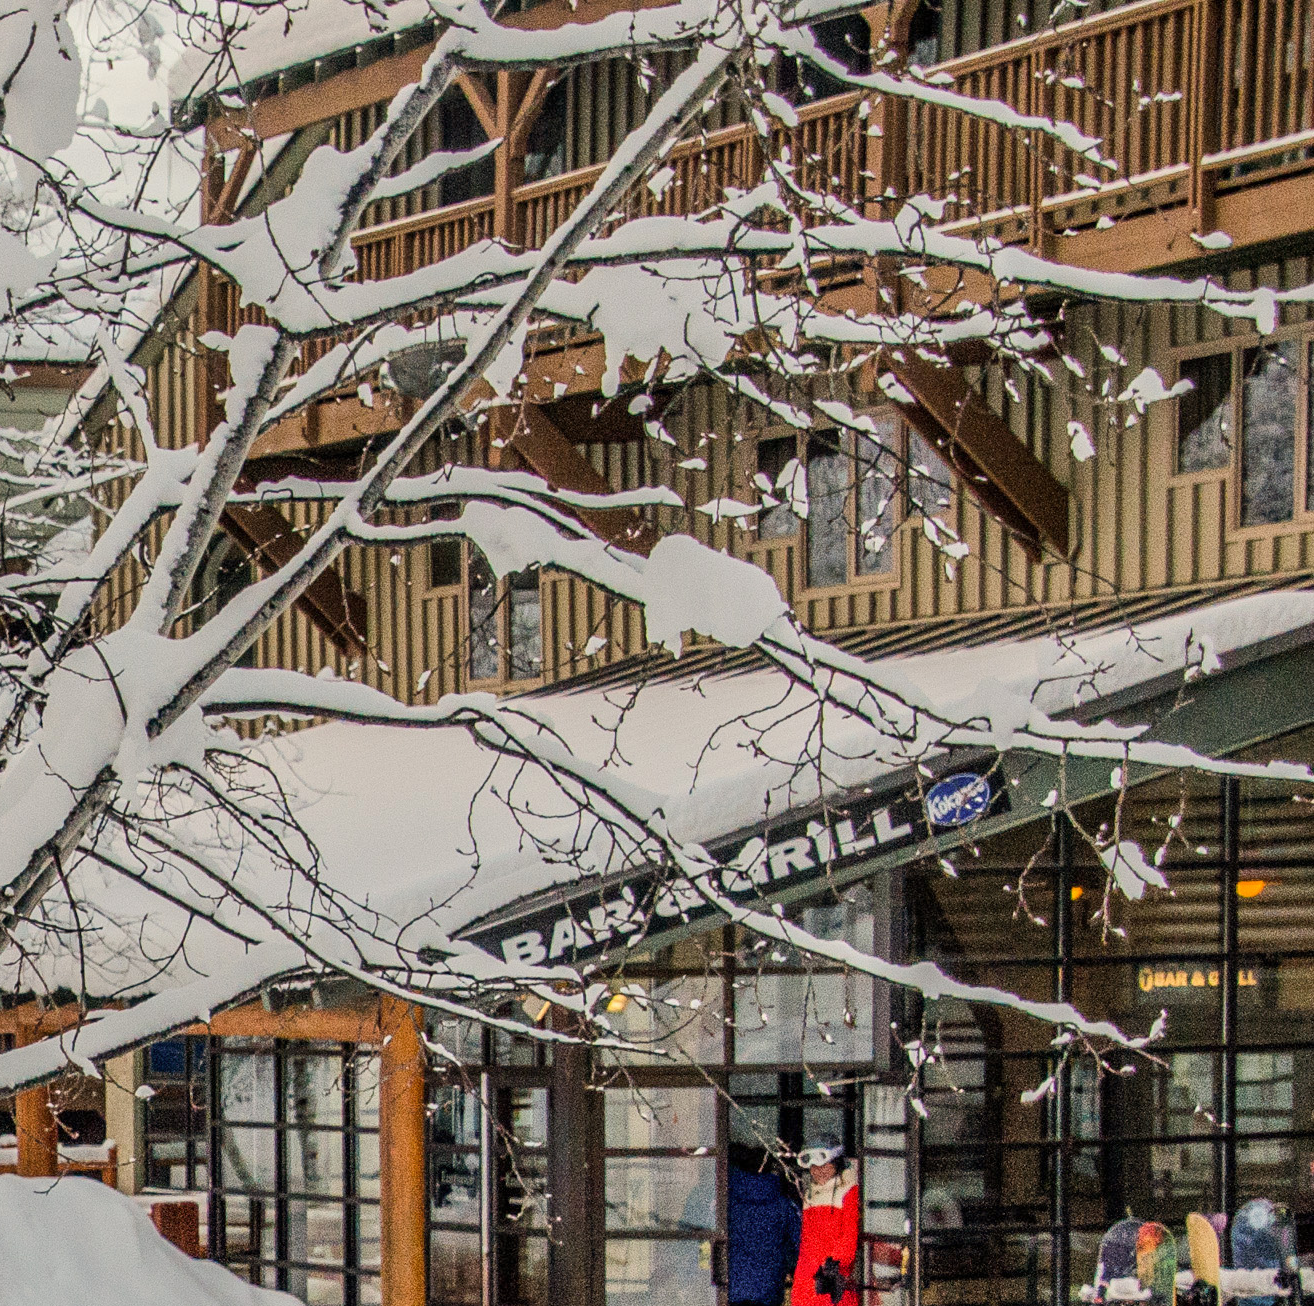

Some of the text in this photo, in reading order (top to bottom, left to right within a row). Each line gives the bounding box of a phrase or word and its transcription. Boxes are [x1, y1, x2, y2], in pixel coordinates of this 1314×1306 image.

[501, 807, 913, 966] BAR & GRILL
[1154, 970, 1189, 988] BAR
[1207, 970, 1258, 988] GLL
